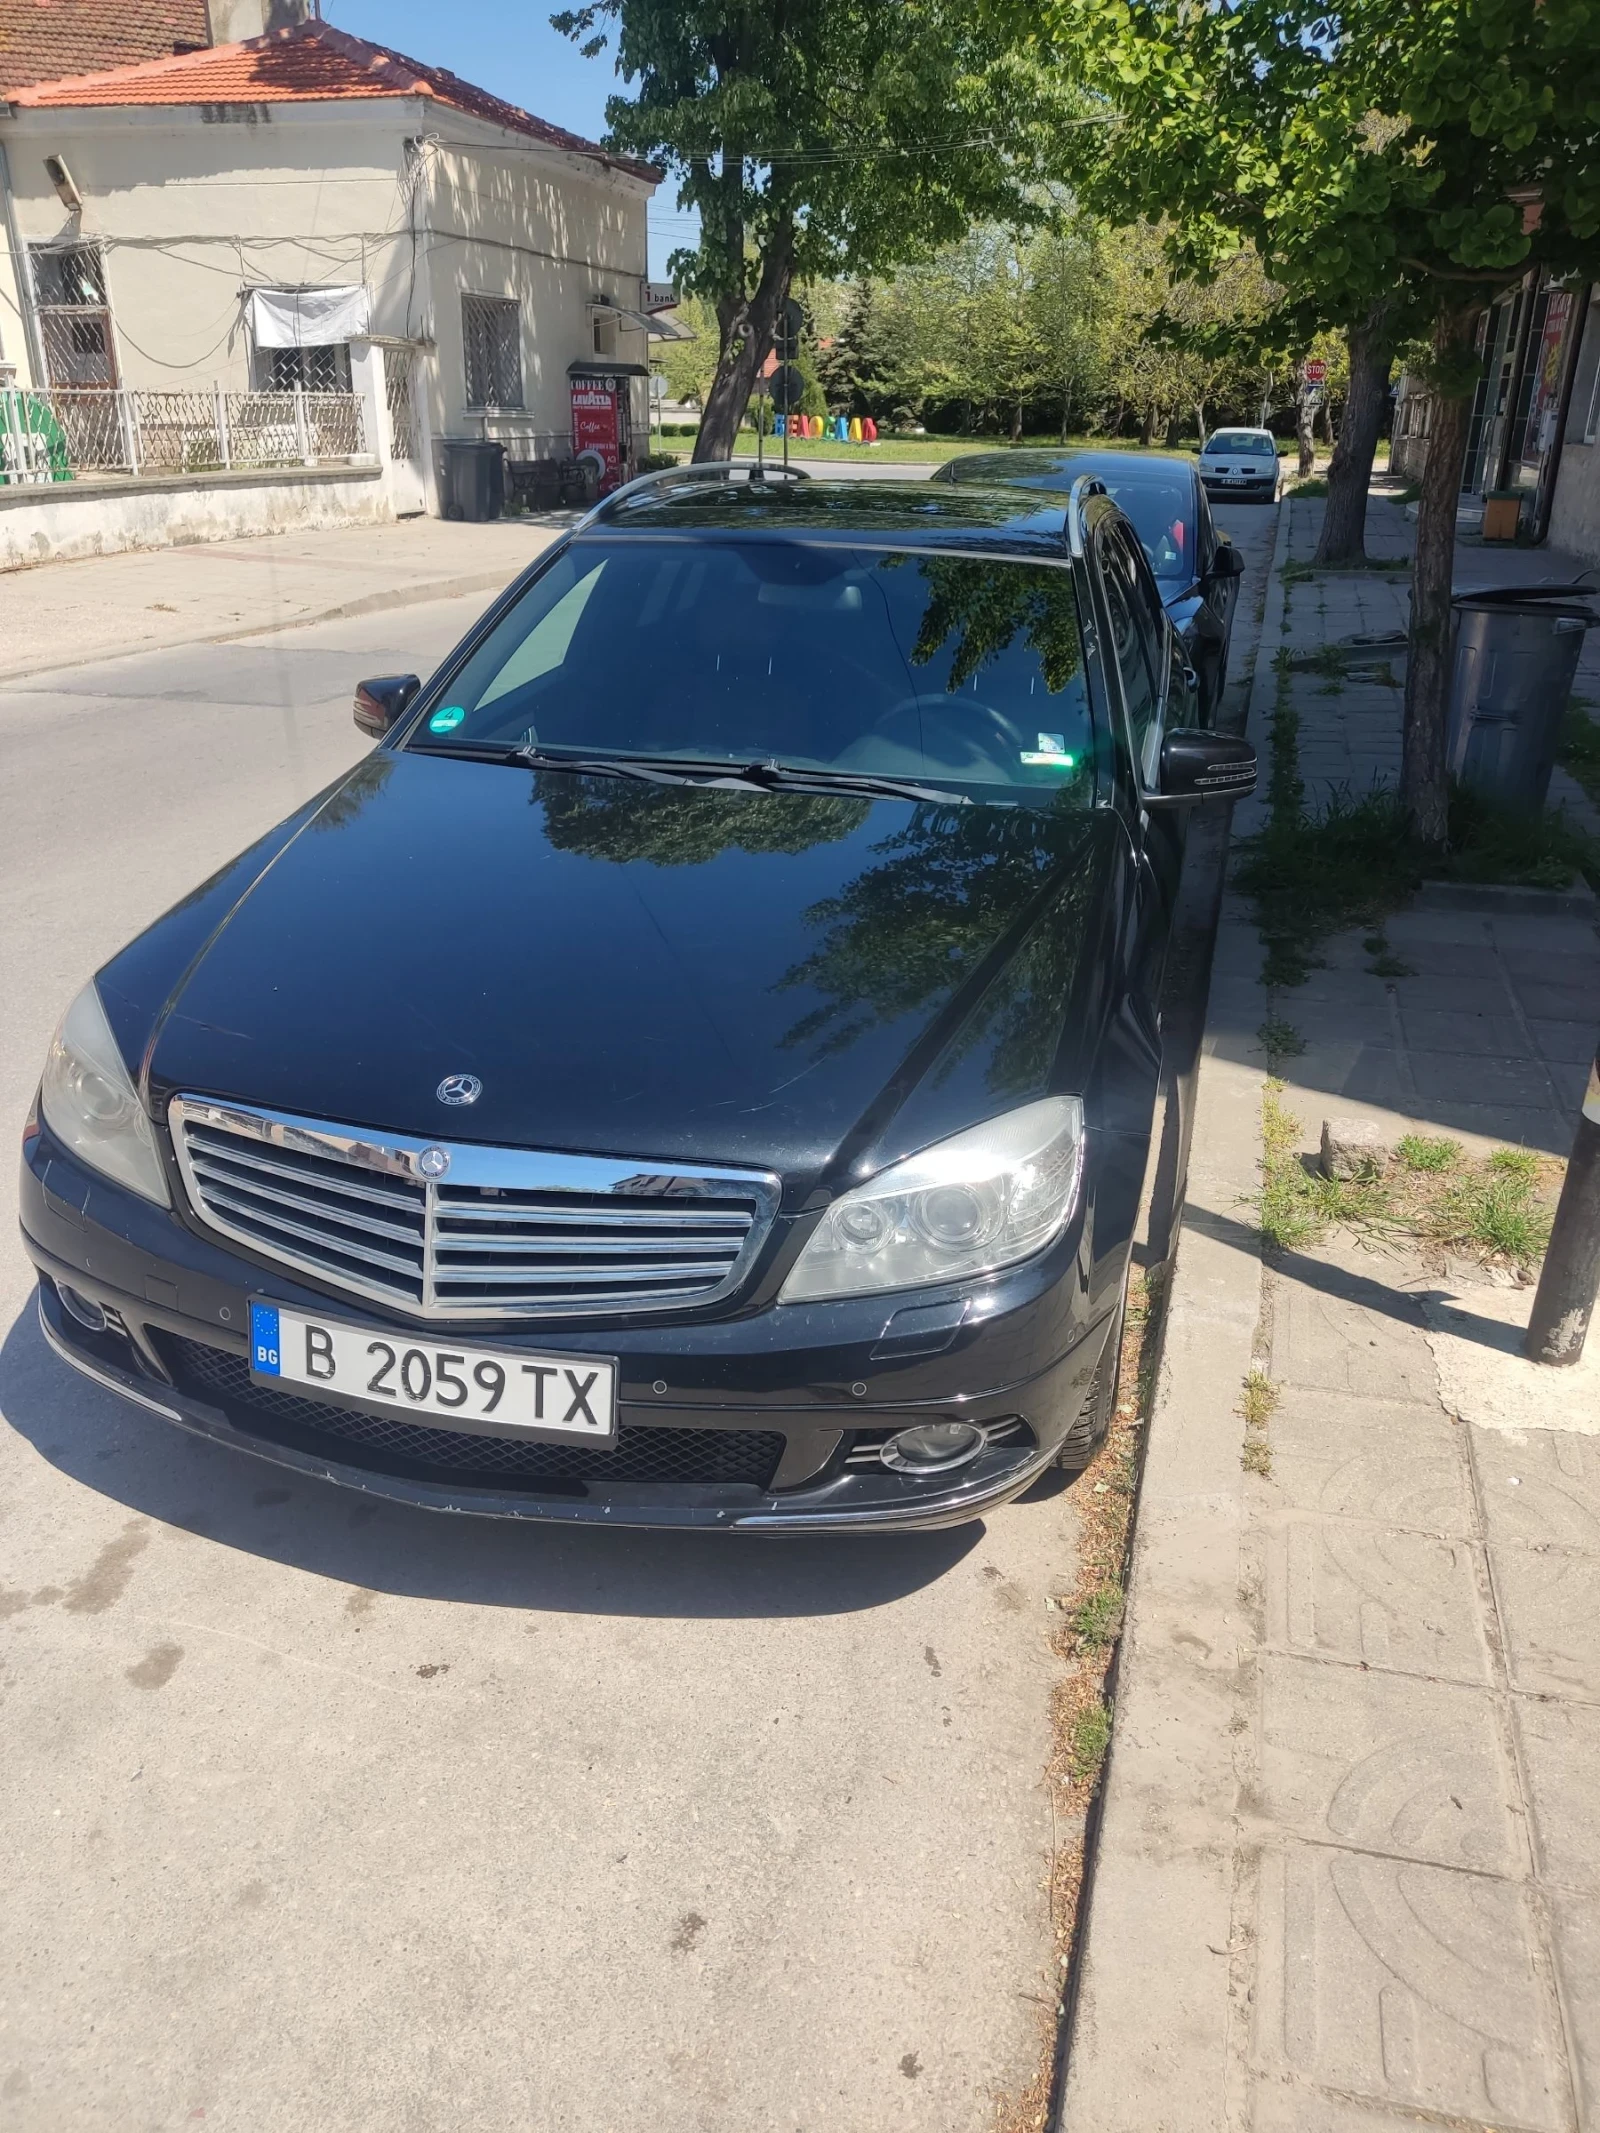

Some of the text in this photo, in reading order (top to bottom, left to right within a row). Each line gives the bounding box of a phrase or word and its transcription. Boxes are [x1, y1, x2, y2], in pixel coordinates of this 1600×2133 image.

[654, 293, 675, 303] bank
[1307, 365, 1325, 375] STOP
[570, 379, 605, 391] COFFEE
[572, 391, 612, 405] LAVAZZA
[580, 421, 600, 433] Coffee
[257, 1345, 278, 1366] BG
[304, 1323, 599, 1426] B 2059 TX
